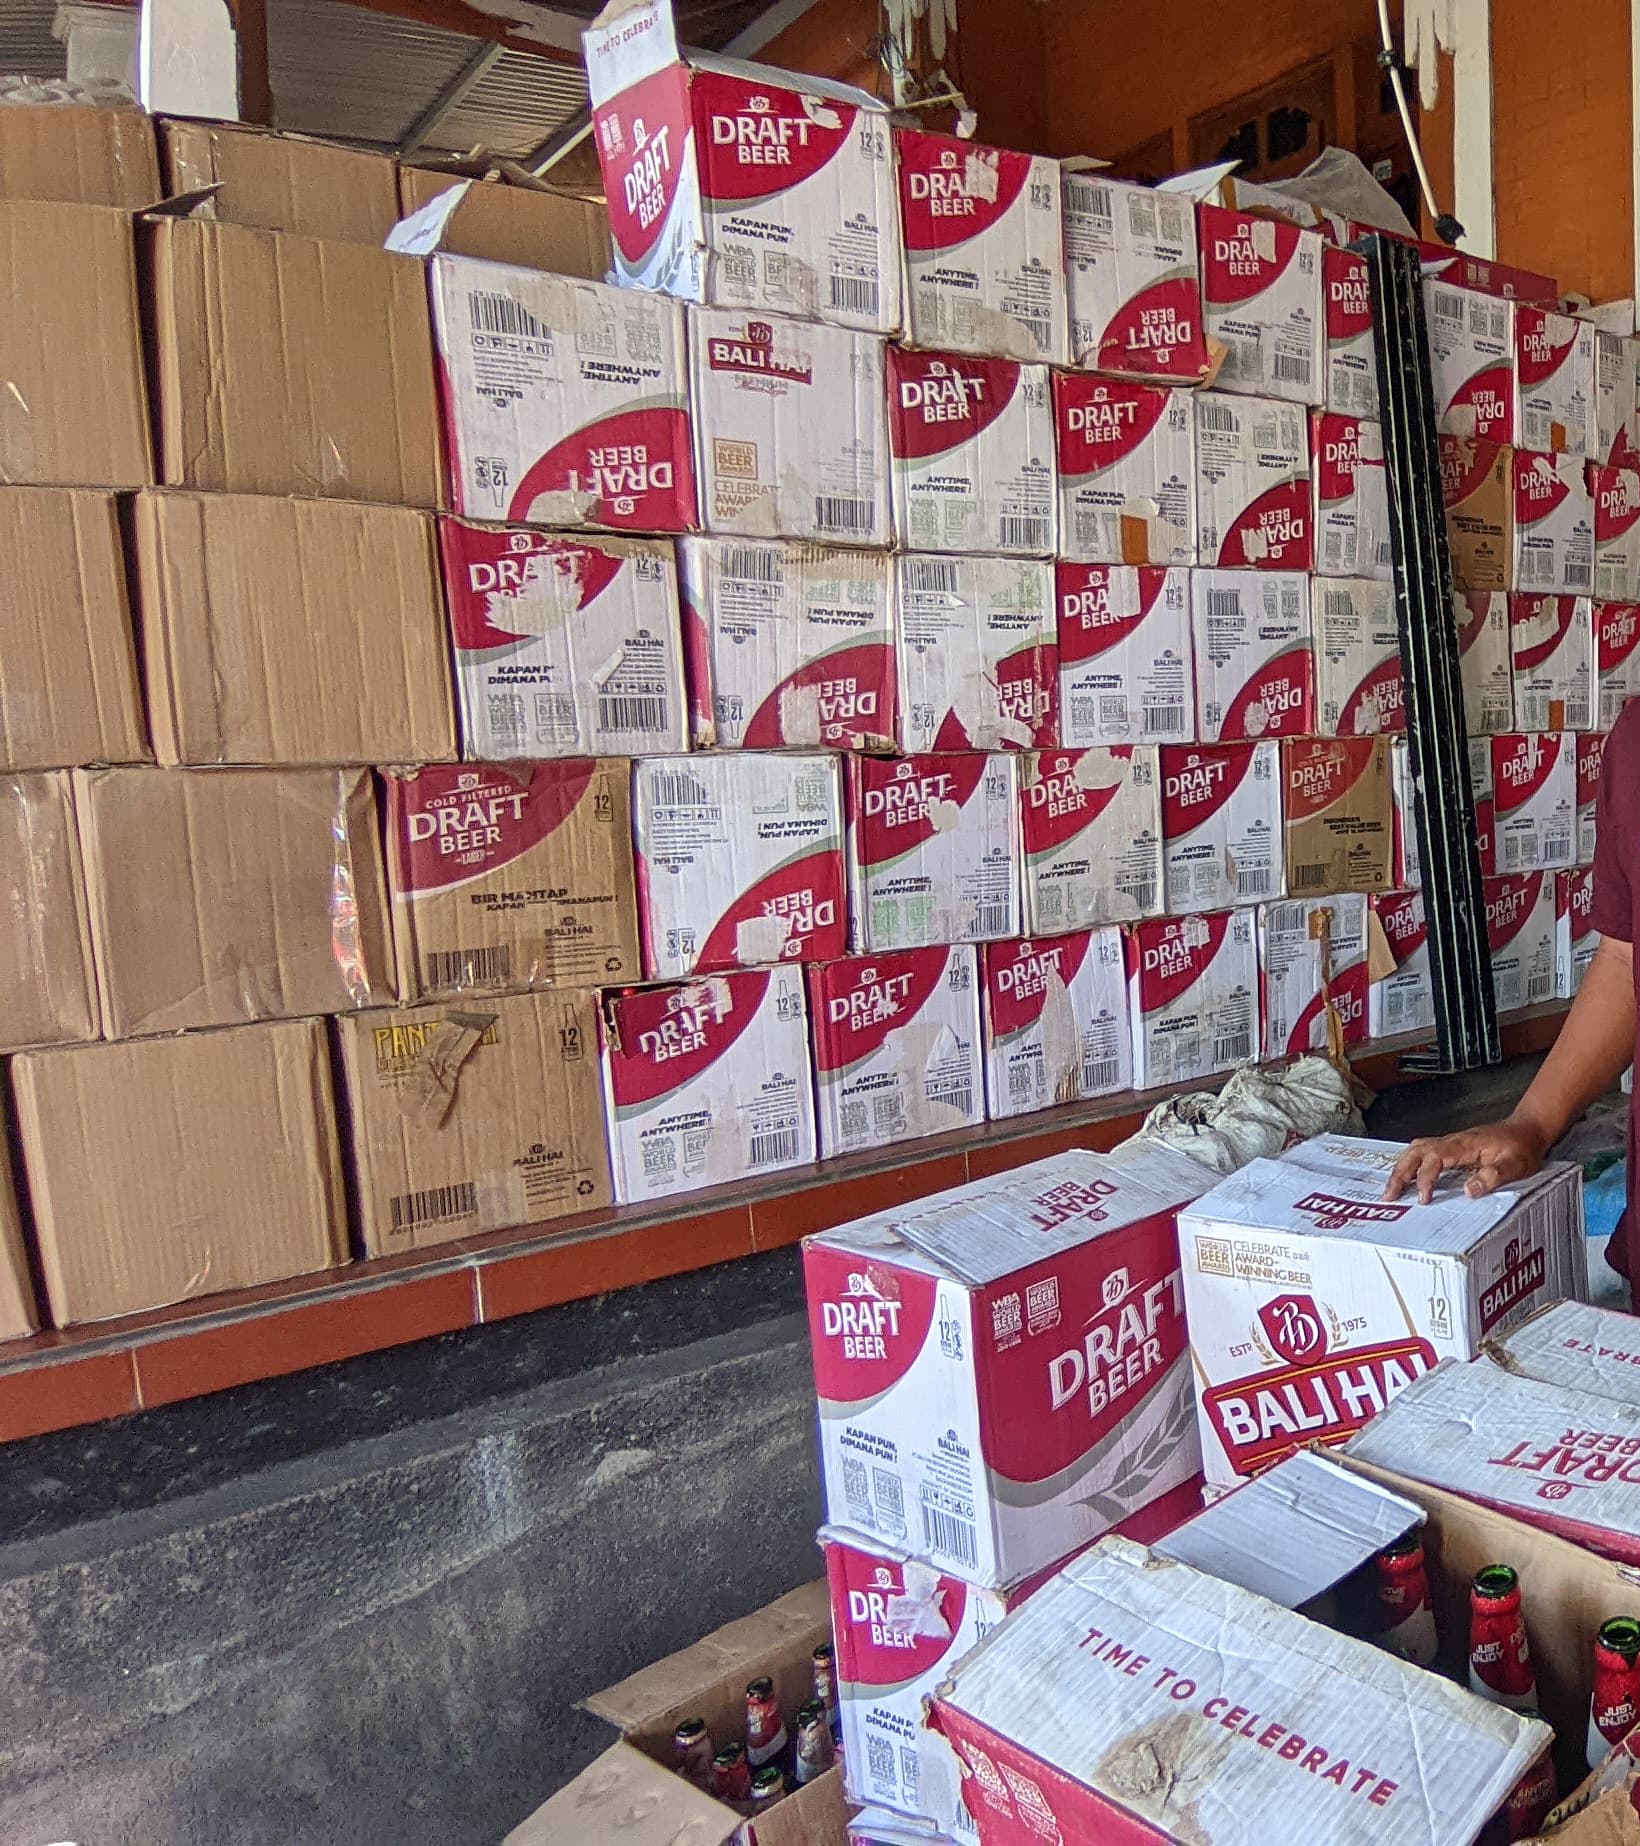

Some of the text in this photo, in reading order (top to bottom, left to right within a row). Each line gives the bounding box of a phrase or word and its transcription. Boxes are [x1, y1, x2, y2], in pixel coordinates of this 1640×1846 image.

[712, 115, 814, 145] DRAFT
[859, 131, 872, 149] 12
[738, 145, 790, 165] BEER
[624, 125, 671, 216] DRAFT
[638, 183, 666, 230] BEER
[931, 198, 974, 217] BEER
[722, 224, 763, 239] DIMANA
[731, 216, 769, 232] KAPAN
[1228, 260, 1261, 276] BEER
[1141, 308, 1175, 325] BEER
[1343, 301, 1368, 314] BEER
[1126, 327, 1192, 350] DRAFT
[714, 344, 765, 366] BALI
[900, 378, 986, 409] DRAFT
[1472, 391, 1496, 404] BEER
[923, 404, 971, 423] BEER
[1067, 402, 1138, 431] DRAFT
[1085, 424, 1122, 444] BEER
[588, 446, 647, 467] BEER
[718, 453, 753, 468] BEER
[493, 469, 509, 486] 12
[1529, 486, 1552, 500] BEER
[1259, 507, 1290, 525] BEER
[1609, 505, 1630, 519] BEER
[625, 638, 646, 646] BALI
[488, 675, 538, 684] DIMANA
[498, 665, 542, 675] KAPAN
[1261, 677, 1290, 697] BEER
[1166, 761, 1227, 798] DRAFT
[1291, 758, 1343, 789] DRAFT
[1512, 769, 1534, 787] BEER
[865, 774, 951, 817] DRAFT
[1180, 785, 1213, 808] BEER
[1303, 778, 1332, 797] BEER
[425, 796, 456, 810] COLD
[594, 794, 610, 810] 12
[1048, 795, 1088, 819] BEER
[408, 793, 529, 843] DRAFT
[885, 805, 930, 828] BEER
[439, 826, 501, 856] BEER
[762, 889, 814, 916] BEER
[1486, 889, 1527, 922] DRAFT
[1496, 909, 1518, 929] BEER
[1395, 919, 1421, 941] BEER
[949, 970, 959, 984] 12
[998, 948, 1064, 993] DRAFT
[1160, 956, 1193, 979] BEER
[776, 997, 788, 1011] 12
[830, 972, 914, 1024] DRAFT
[559, 1028, 578, 1047] 12
[654, 1032, 707, 1064] BEER
[1030, 1181, 1081, 1206] BEER
[1030, 1179, 1120, 1231] DRAFT
[1302, 1197, 1402, 1219] BALI HAI
[1200, 1250, 1229, 1262] BEER
[1234, 1240, 1290, 1258] CELEBRATE
[1236, 1264, 1286, 1280] WINNING
[1288, 1271, 1312, 1284] BEER
[1482, 1255, 1542, 1317] BALI HAI
[992, 1292, 1020, 1310] WBA
[1030, 1289, 1055, 1306] BEER
[822, 1300, 902, 1337] DRAFT
[1428, 1296, 1446, 1321] 12
[994, 1311, 1021, 1330] BEER
[1342, 1316, 1368, 1332] 1975
[938, 1320, 952, 1343] 12
[1048, 1268, 1184, 1411] DRAFT
[843, 1336, 887, 1360] BEER
[1087, 1335, 1164, 1420] BEER
[1217, 1352, 1430, 1447] BALI HAI
[840, 1435, 874, 1455] DIMANA
[846, 1426, 898, 1453] KAPAN PUN,
[938, 1437, 970, 1458] BALI HAI
[1472, 1650, 1504, 1663] ENJOY
[1475, 1641, 1501, 1654] JUST
[865, 1713, 900, 1736] DIMANA
[872, 1707, 903, 1727] KAPAN
[1075, 1626, 1403, 1809] TIME TO CELEBRATE
[1599, 1709, 1637, 1727] ENJOY
